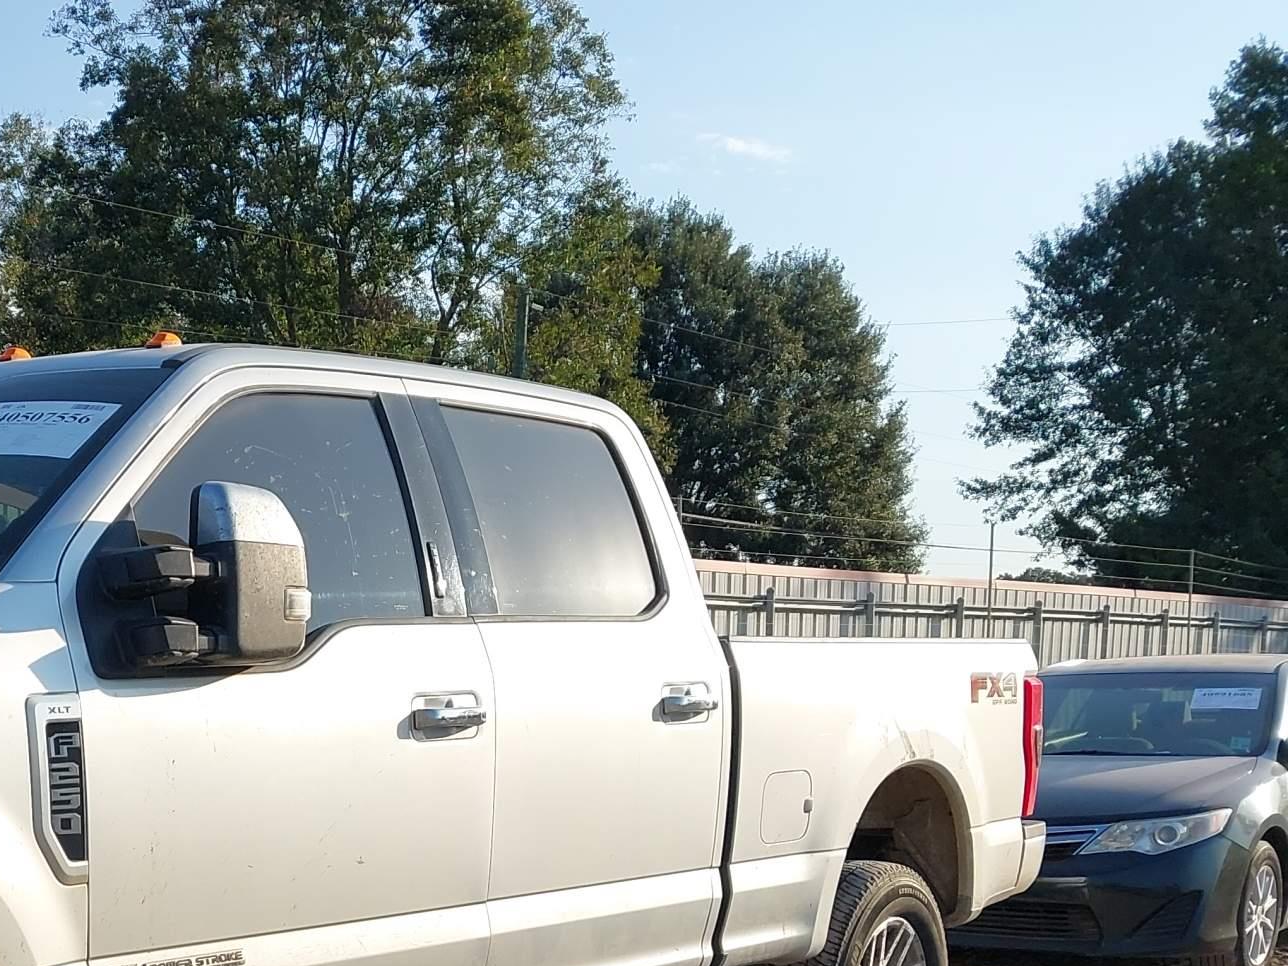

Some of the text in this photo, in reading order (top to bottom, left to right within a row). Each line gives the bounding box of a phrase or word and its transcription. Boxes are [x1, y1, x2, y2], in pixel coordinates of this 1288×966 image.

[970, 671, 1018, 704] FX4
[47, 706, 72, 715] XLT
[48, 732, 82, 835] F250
[195, 950, 244, 966] STROKE
